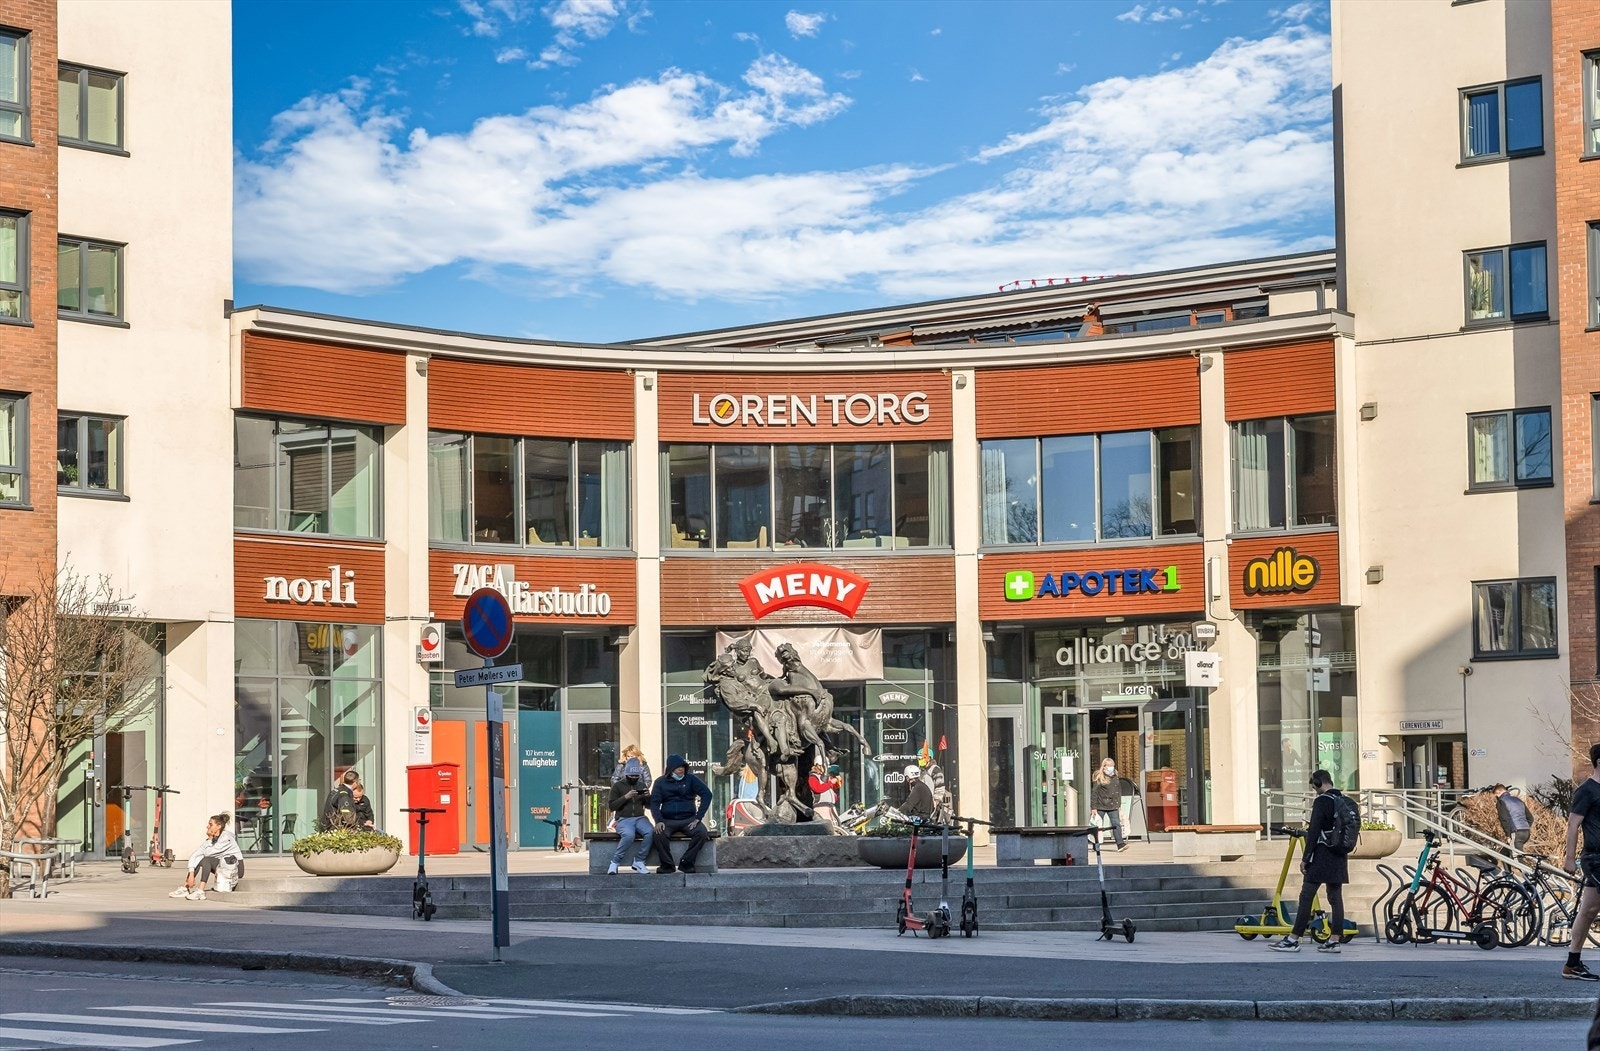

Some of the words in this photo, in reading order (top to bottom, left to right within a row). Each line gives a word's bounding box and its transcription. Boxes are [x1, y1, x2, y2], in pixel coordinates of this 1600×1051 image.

[824, 391, 930, 425] TORG
[1248, 550, 1315, 589] nille
[263, 564, 358, 607] norli
[453, 563, 508, 597] ZAGA
[754, 572, 856, 606] MENY
[507, 581, 612, 616] Hårstudio
[458, 675, 475, 684] Peter
[478, 672, 504, 682] Møllers
[507, 667, 518, 679] vei
[1119, 683, 1154, 696] Løren
[882, 693, 907, 702] MENY
[1402, 721, 1431, 729] LØRENVEIEN
[884, 732, 905, 740] norli
[525, 749, 533, 757] 107
[544, 749, 555, 757] med
[1033, 749, 1080, 762] Synklinikk
[522, 758, 558, 768] muligheter
[885, 772, 904, 782] nille
